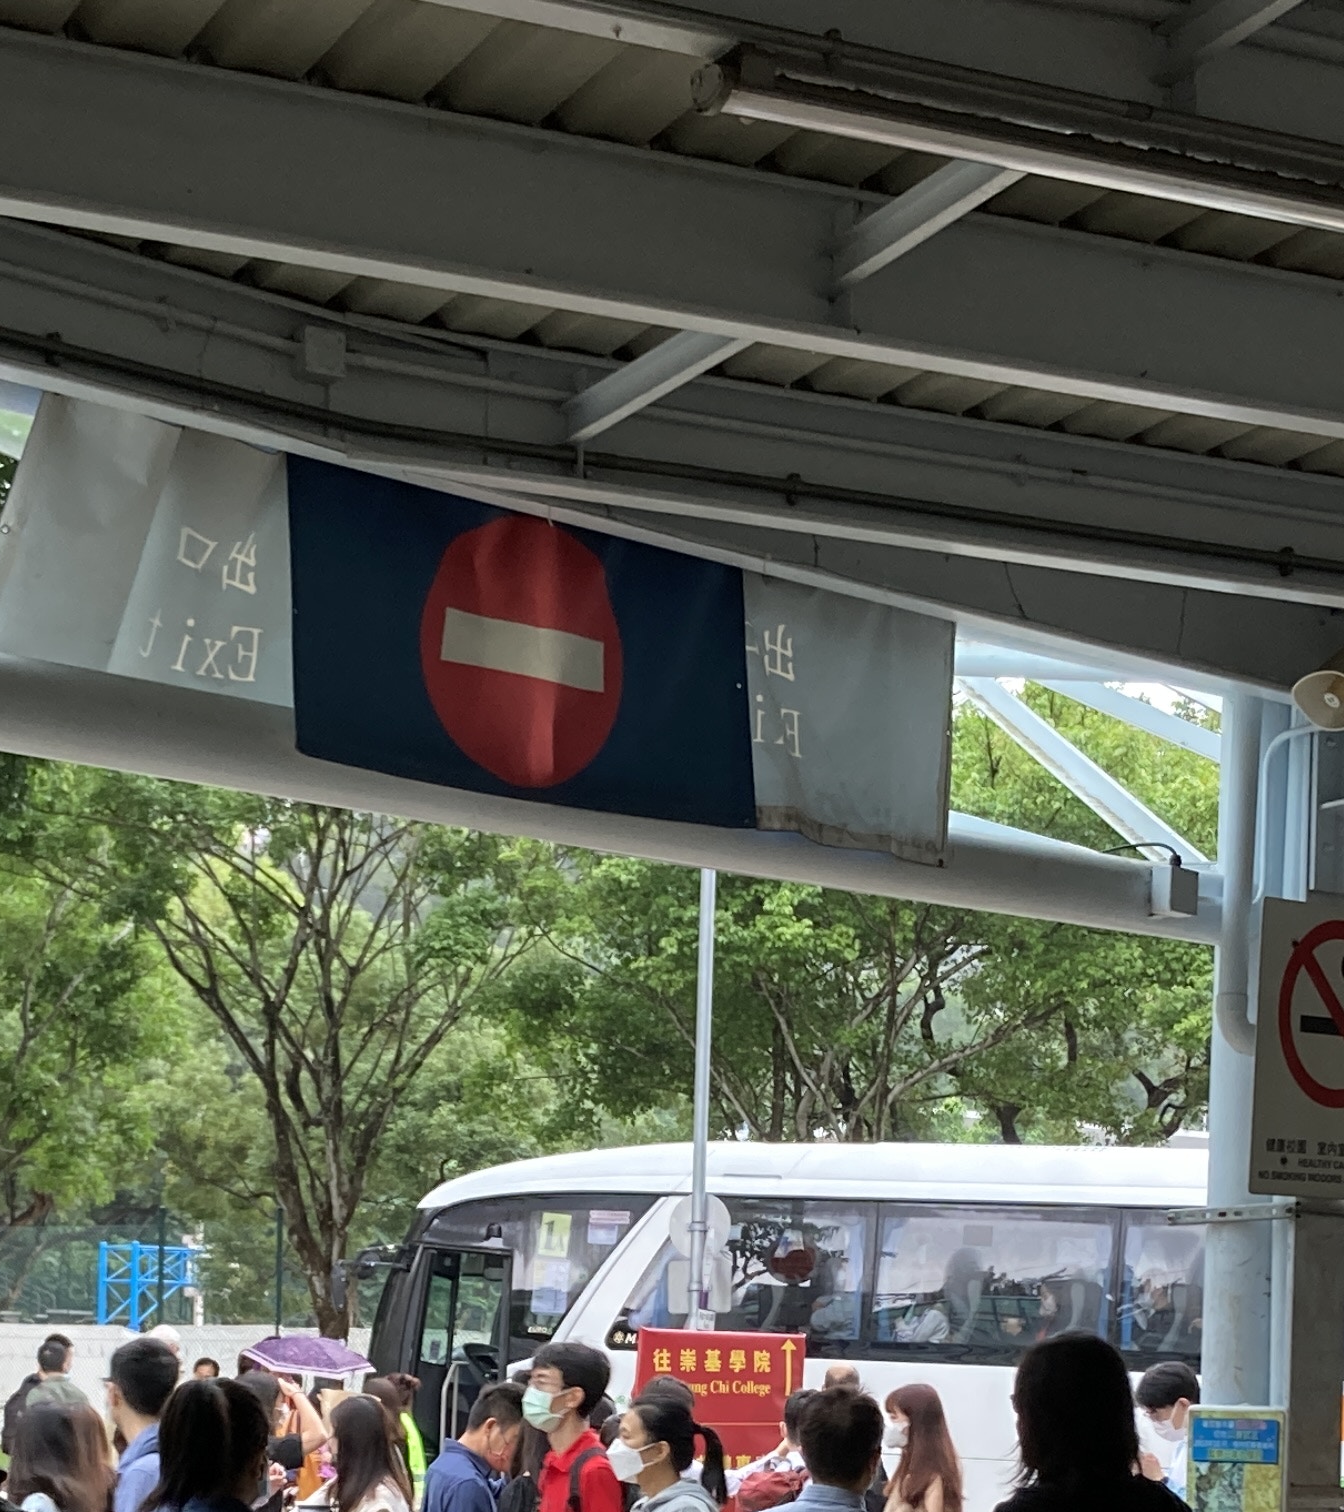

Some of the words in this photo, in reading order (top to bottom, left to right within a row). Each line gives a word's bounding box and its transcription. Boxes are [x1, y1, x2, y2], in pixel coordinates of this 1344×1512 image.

[1298, 1157, 1331, 1170] HEALTHY
[1258, 1170, 1270, 1180] NO
[1271, 1171, 1306, 1183] SMOKING
[1307, 1173, 1342, 1185] INDOORS
[653, 1348, 772, 1374] 往崇基學院
[710, 1380, 730, 1394] Chi
[732, 1380, 772, 1397] College
